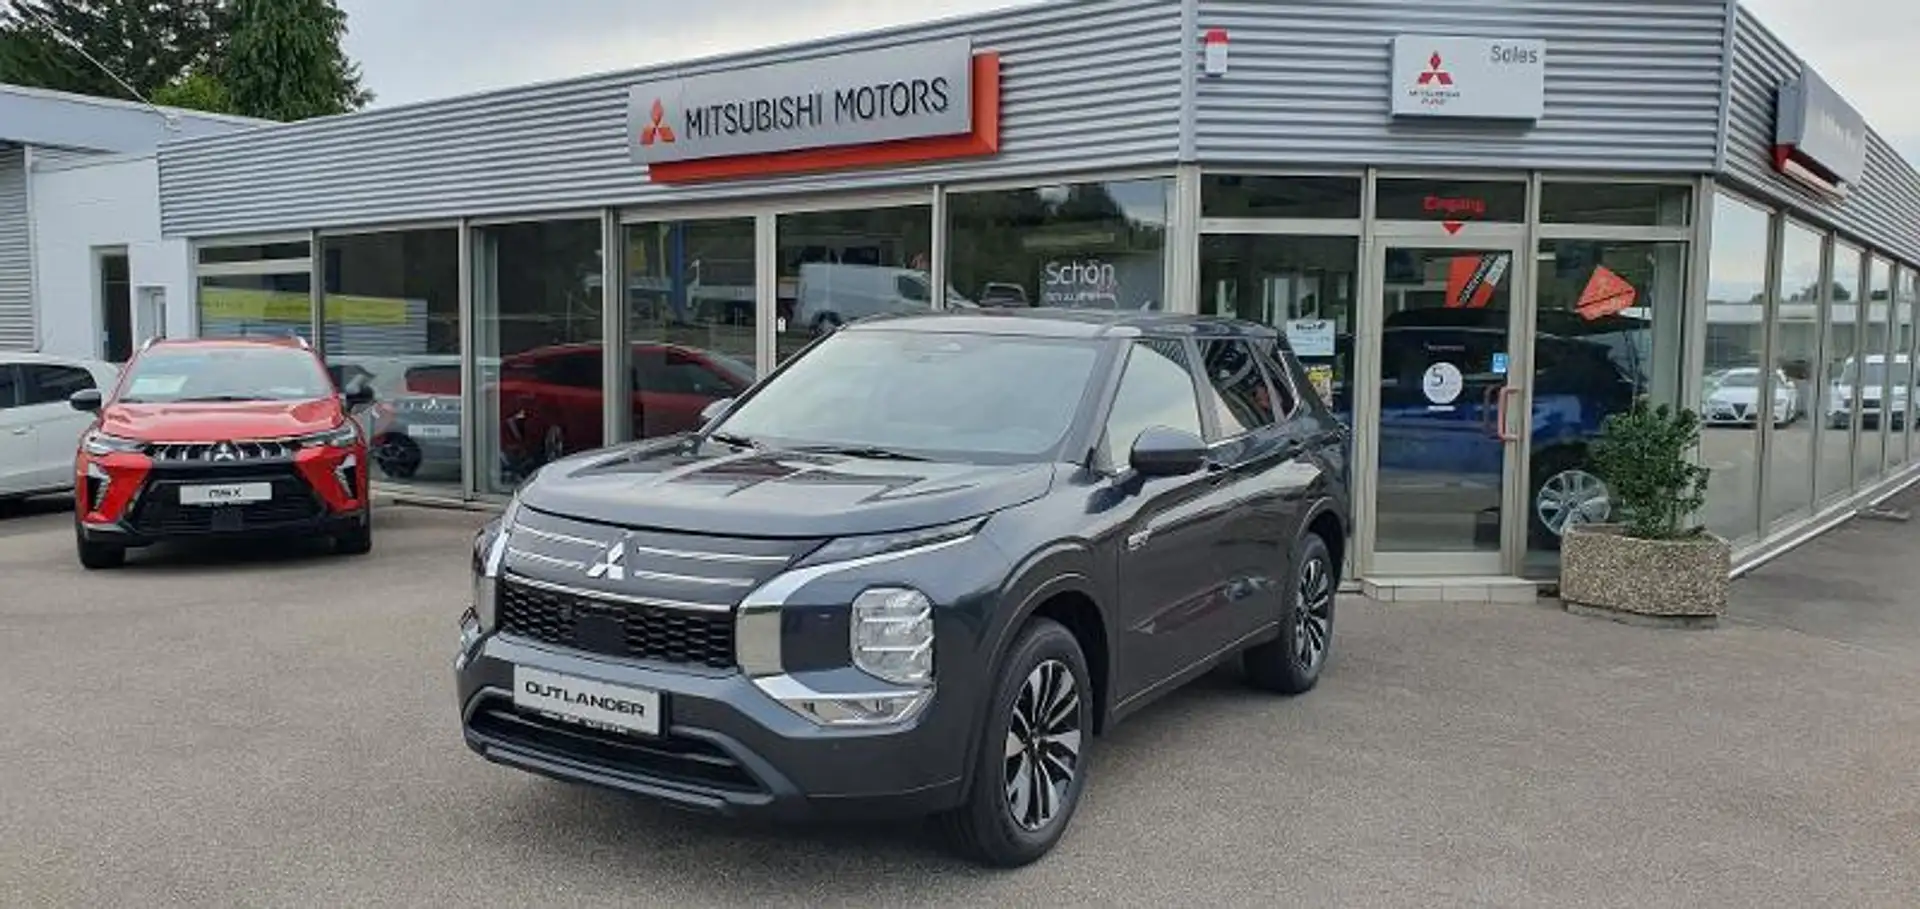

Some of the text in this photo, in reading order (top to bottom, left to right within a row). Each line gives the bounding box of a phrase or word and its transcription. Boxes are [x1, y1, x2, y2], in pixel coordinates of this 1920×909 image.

[1490, 45, 1538, 64] Sales
[685, 76, 949, 140] MITSUBISHI MOTORS
[525, 680, 646, 717] OUTLANDER
